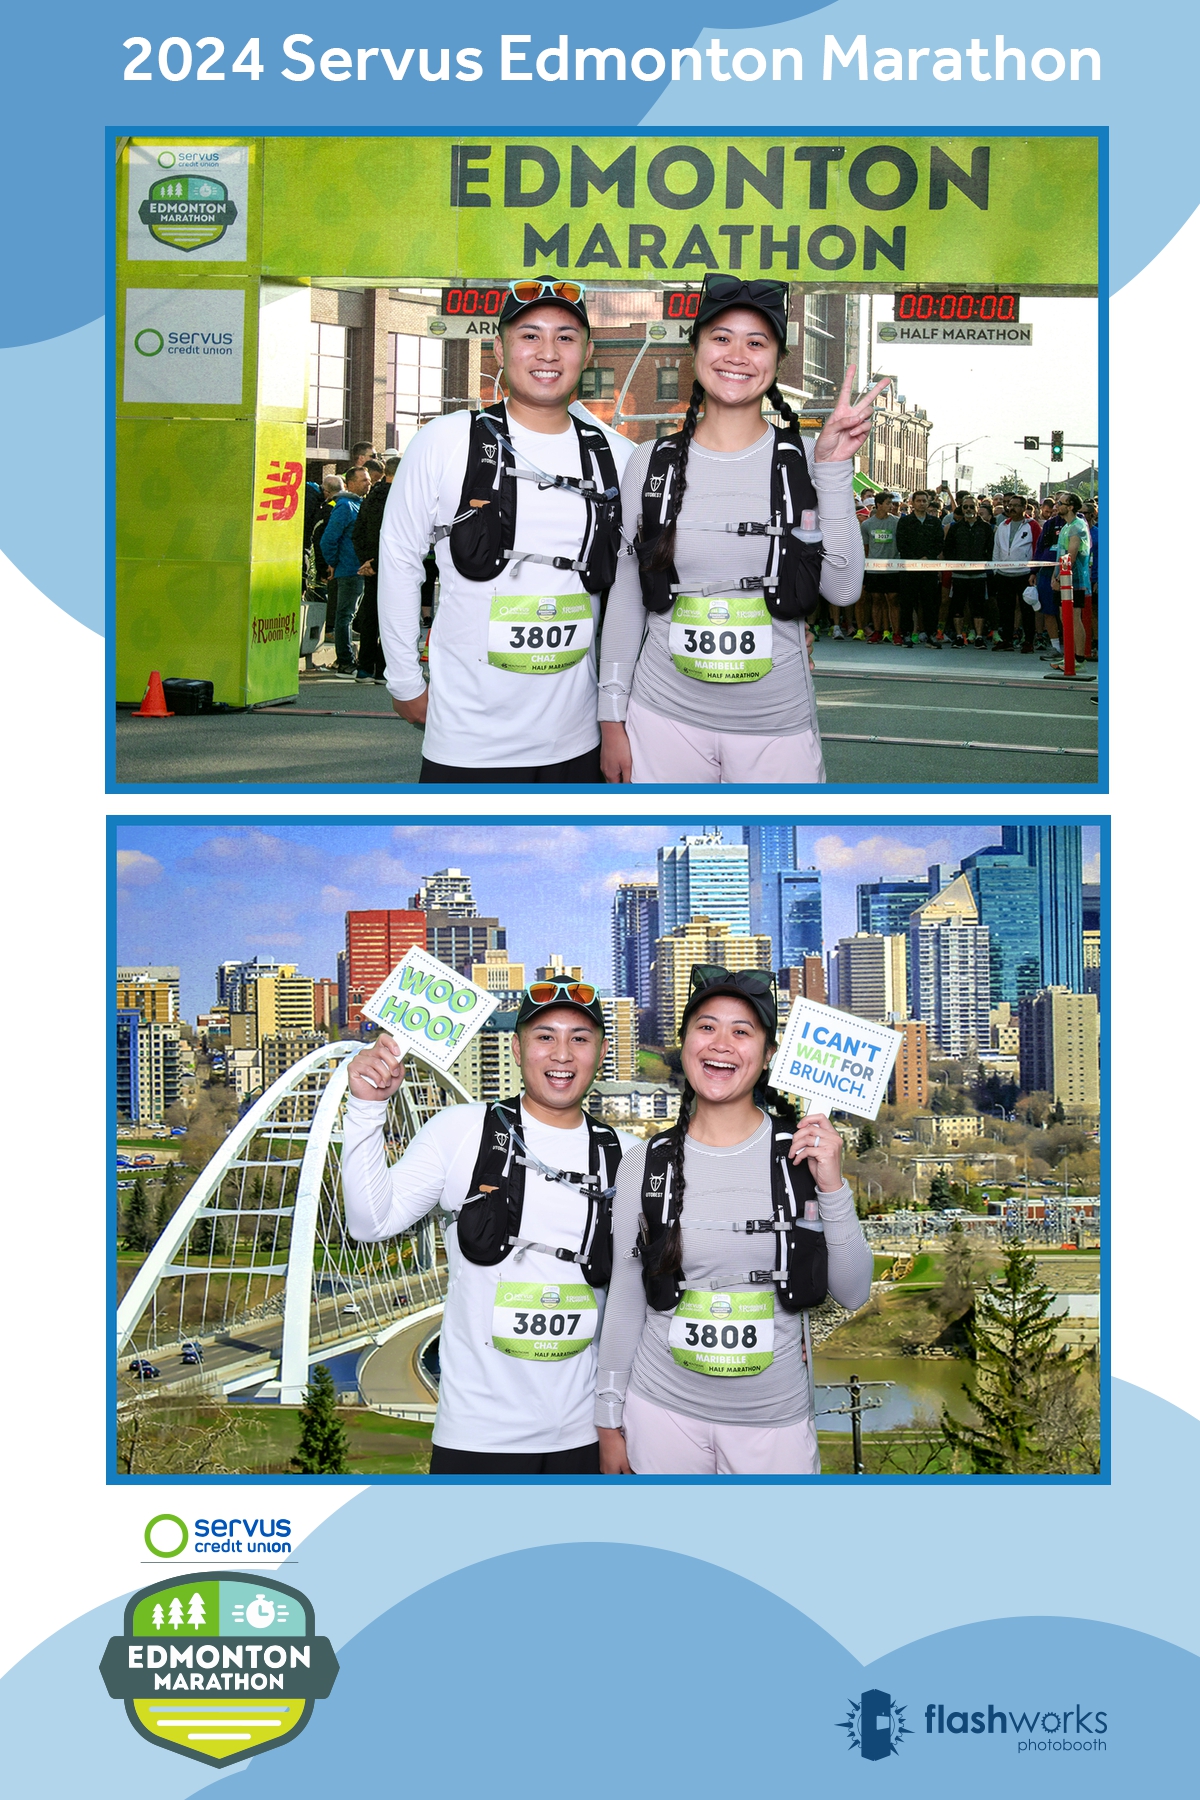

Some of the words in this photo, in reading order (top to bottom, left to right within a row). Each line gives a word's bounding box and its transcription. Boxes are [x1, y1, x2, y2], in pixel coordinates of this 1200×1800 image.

[178, 152, 219, 161] servus
[450, 145, 990, 211] EDMONTON
[149, 203, 227, 214] EDMONTON
[160, 214, 215, 222] MARATHON
[523, 222, 907, 272] MARATHON
[168, 331, 233, 345] servus
[900, 328, 939, 340] HALF
[943, 329, 1031, 341] MARATHON
[168, 345, 200, 355] credit
[203, 346, 233, 355] union
[257, 612, 290, 635] Running
[509, 624, 578, 649] 3807
[684, 629, 756, 655] 3808
[530, 654, 557, 663] CHAZ
[531, 663, 548, 671] HALF
[548, 660, 577, 670] MARATHON
[694, 660, 745, 670] MARIBELLE
[398, 966, 478, 1014] WOO
[377, 995, 466, 1048] HOO!
[801, 1022, 811, 1039] I
[812, 1026, 882, 1063] CAN'T
[796, 1042, 841, 1069] WAIT
[840, 1058, 875, 1082] FOR
[789, 1060, 867, 1099] BRUNCH.
[513, 1312, 581, 1336] 3807
[685, 1322, 758, 1349] 3808
[533, 1341, 559, 1350] CHAZ
[550, 1349, 579, 1358] MARATHON
[695, 1353, 747, 1365] MARIBELLE
[726, 1365, 762, 1373] MARATHON
